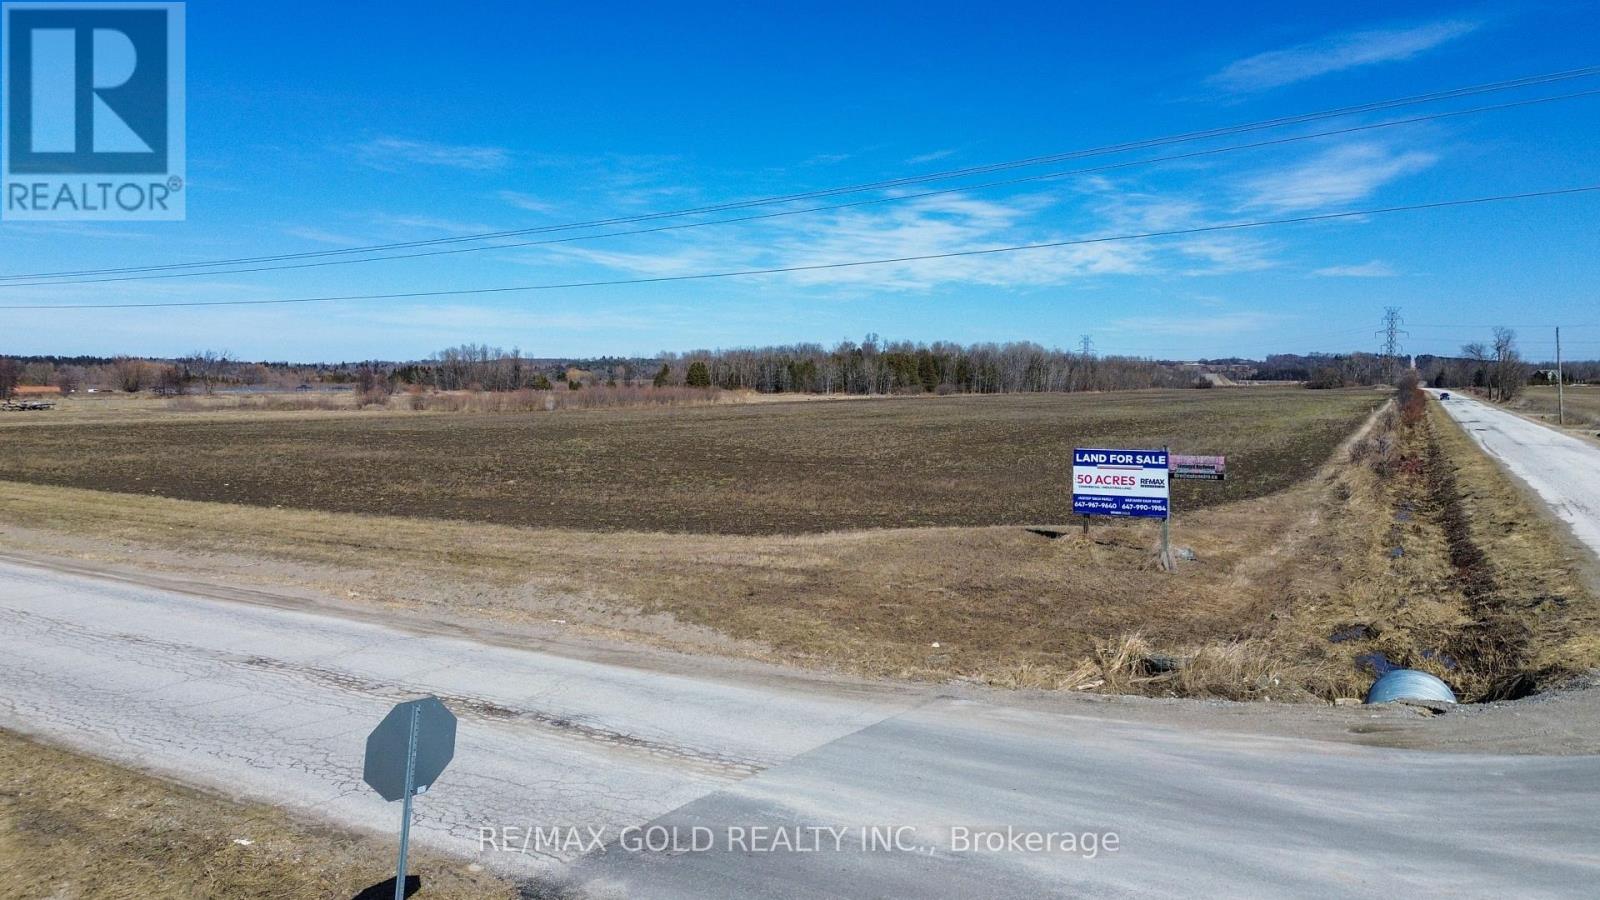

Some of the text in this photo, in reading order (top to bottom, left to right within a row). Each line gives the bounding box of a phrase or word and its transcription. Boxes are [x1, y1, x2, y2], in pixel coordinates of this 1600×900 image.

[1076, 453, 1166, 464] LAND FOR SALE
[1077, 474, 1136, 486] 50 ACRES
[1074, 501, 1117, 509] 647-967-9640
[1121, 503, 1166, 511] 647-990-1984
